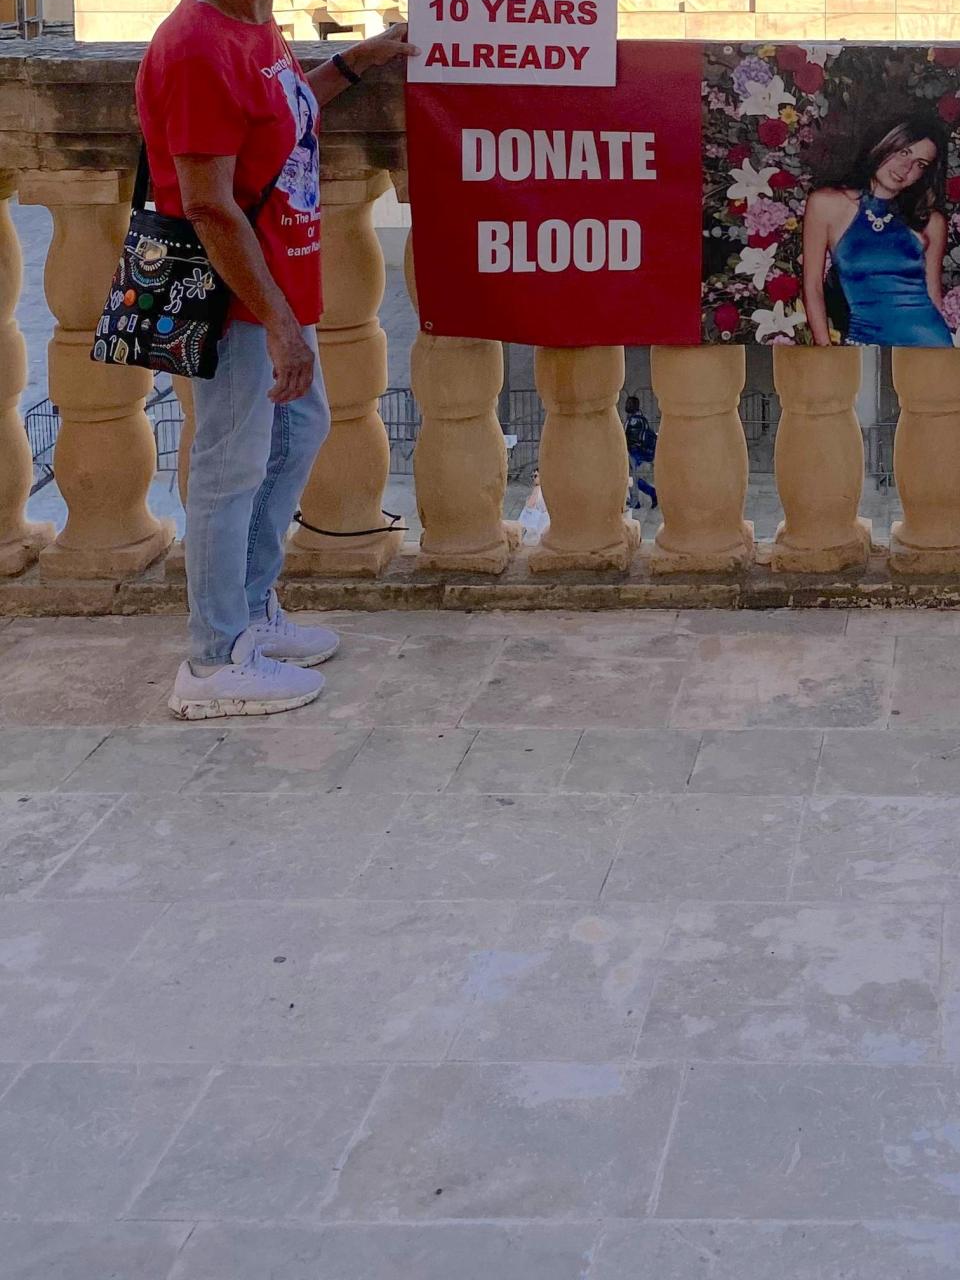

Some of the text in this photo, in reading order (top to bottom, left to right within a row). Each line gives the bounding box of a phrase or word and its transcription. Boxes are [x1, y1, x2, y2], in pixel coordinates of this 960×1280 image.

[425, 42, 590, 70] ALREADY
[461, 128, 657, 182] DONATE
[280, 214, 293, 226] In
[477, 219, 642, 273] BLOOD
